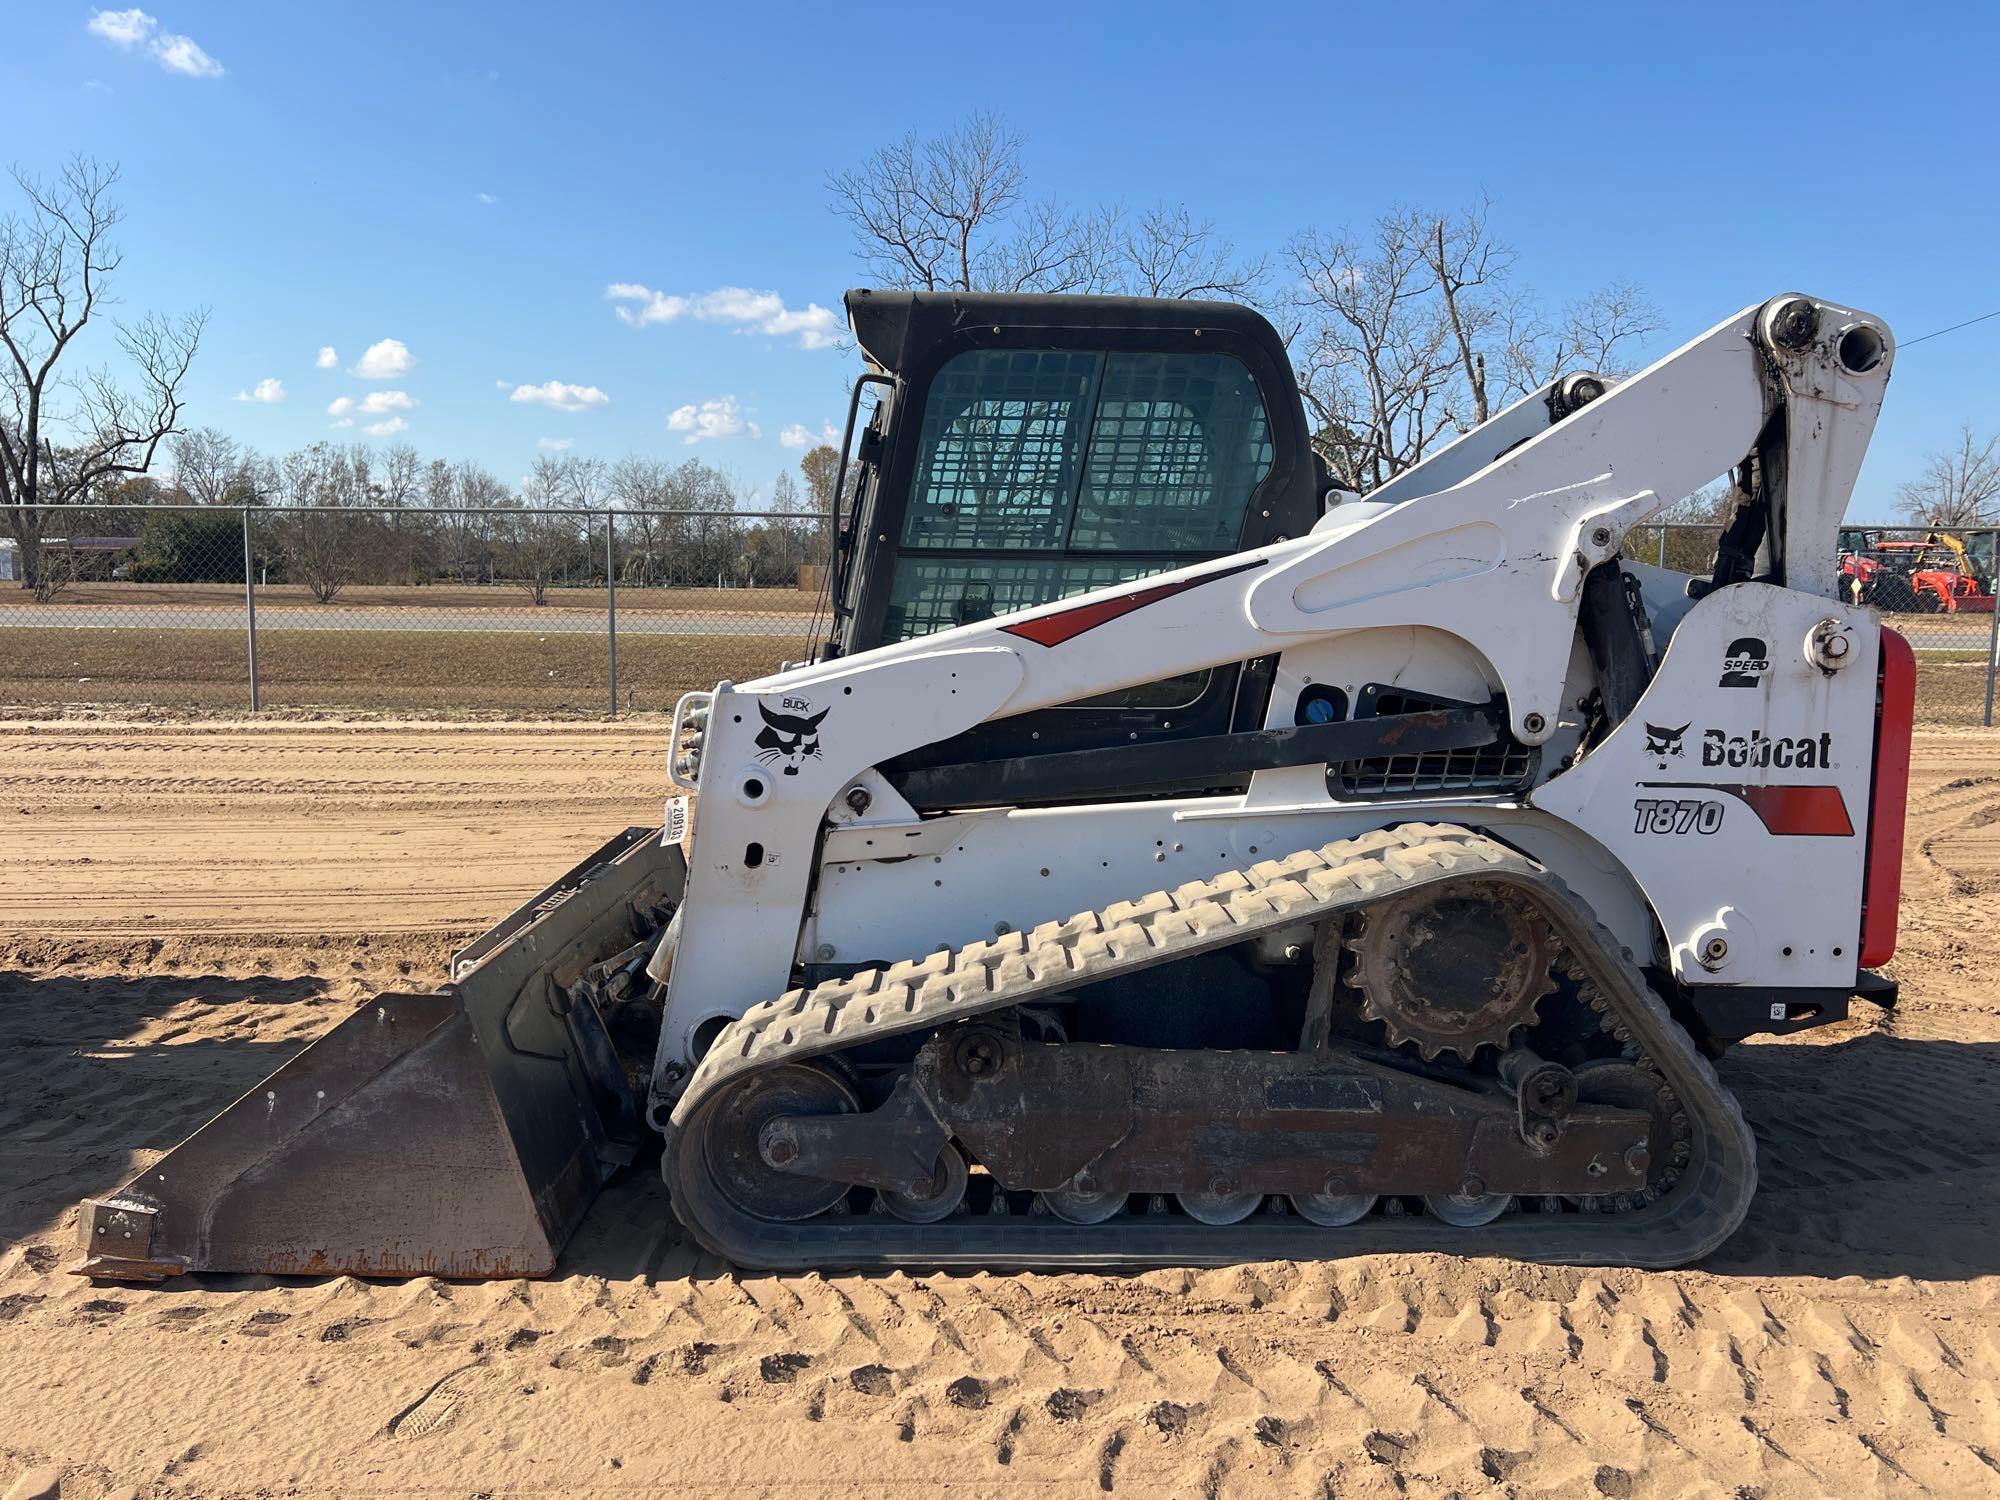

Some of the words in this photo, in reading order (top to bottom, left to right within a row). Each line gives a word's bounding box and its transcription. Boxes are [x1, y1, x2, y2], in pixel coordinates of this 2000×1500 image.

[1719, 637, 1767, 688] 2
[1723, 660, 1769, 671] SPEED
[783, 698, 810, 712] BUCK
[1702, 729, 1831, 769] Bobcat
[671, 808, 684, 840] 209133
[1634, 799, 1724, 834] T870
